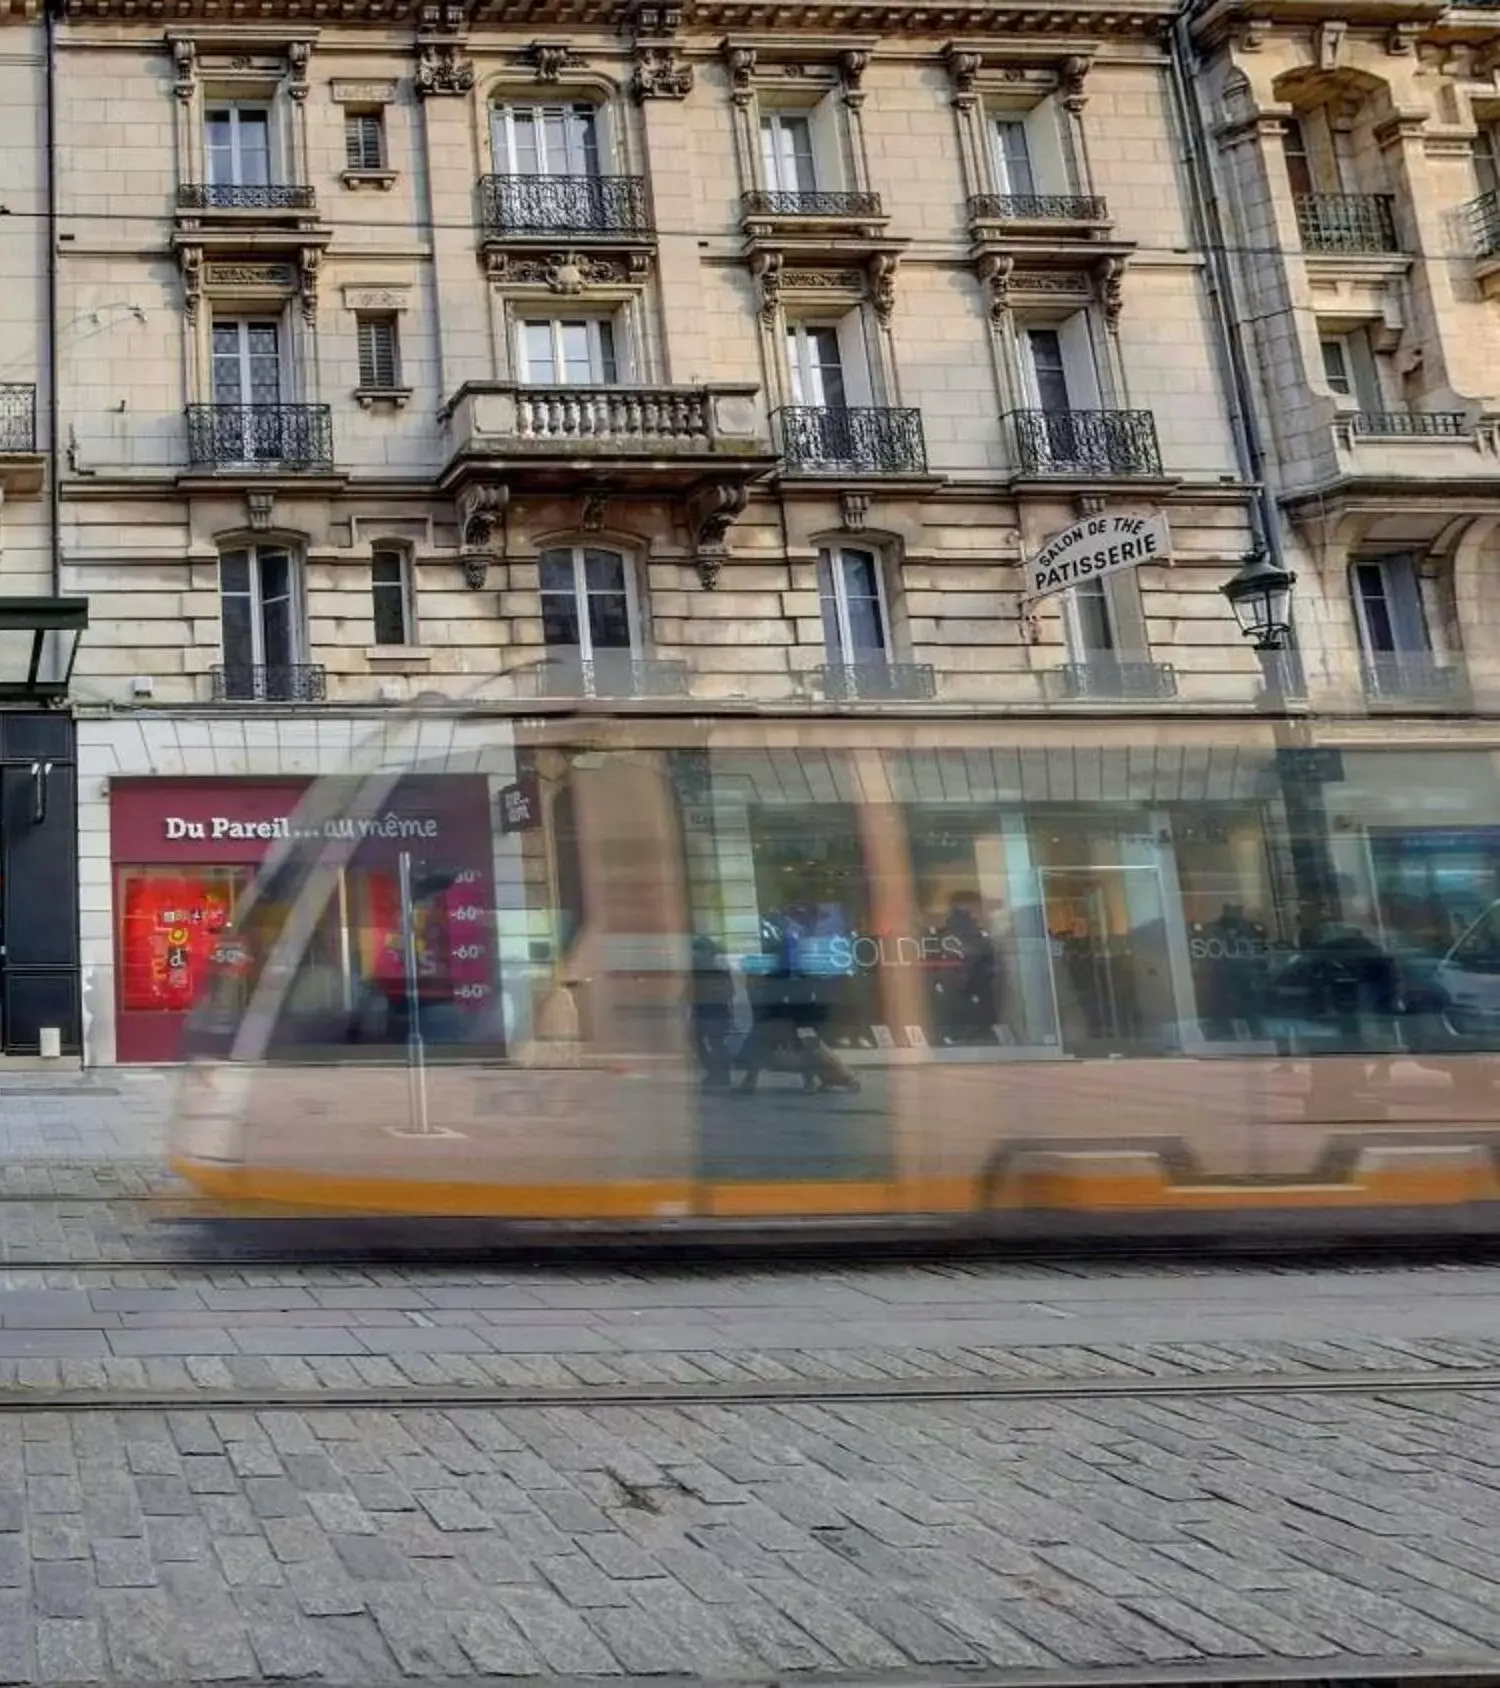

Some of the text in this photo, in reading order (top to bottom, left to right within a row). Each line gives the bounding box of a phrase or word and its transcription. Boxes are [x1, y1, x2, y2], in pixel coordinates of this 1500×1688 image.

[1035, 533, 1157, 590] PATISSERIE
[1039, 517, 1144, 567] SALON DE THE
[165, 817, 205, 839] Du
[324, 823, 354, 839] au
[358, 812, 437, 838] même
[829, 934, 964, 968] SOLDES
